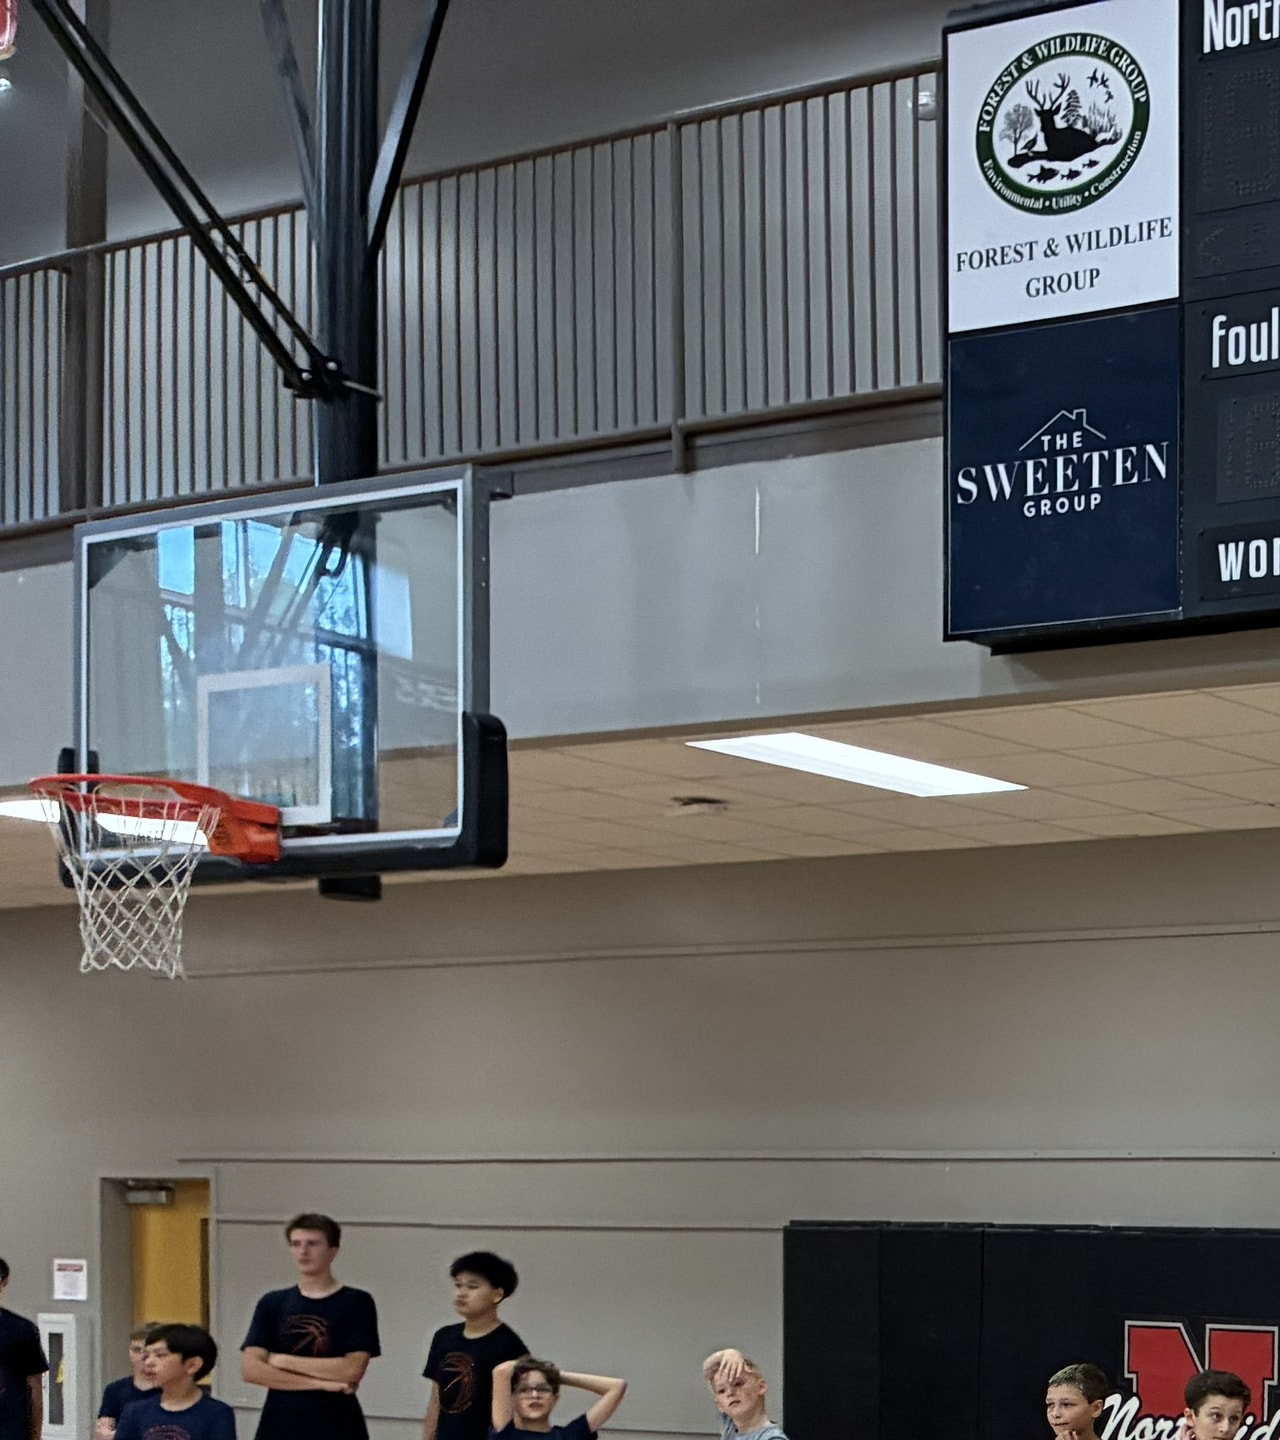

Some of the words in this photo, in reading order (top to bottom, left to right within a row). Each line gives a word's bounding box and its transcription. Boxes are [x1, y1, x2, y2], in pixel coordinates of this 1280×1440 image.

[979, 63, 1020, 132] FOREST
[1021, 51, 1034, 70] &
[1035, 34, 1109, 60] WILDLIFE
[1110, 46, 1148, 103] GROUP
[983, 158, 1044, 210] Environmental
[1051, 193, 1084, 210] Utility
[1090, 131, 1142, 196] Construction
[956, 241, 1038, 272] FOREST
[1043, 237, 1060, 259] &
[1065, 216, 1173, 252] WILDLIFE
[1026, 268, 1101, 298] GROUP
[1041, 431, 1083, 452] THE
[957, 441, 1170, 505] SWEETEN
[1023, 493, 1102, 518] GROUP
